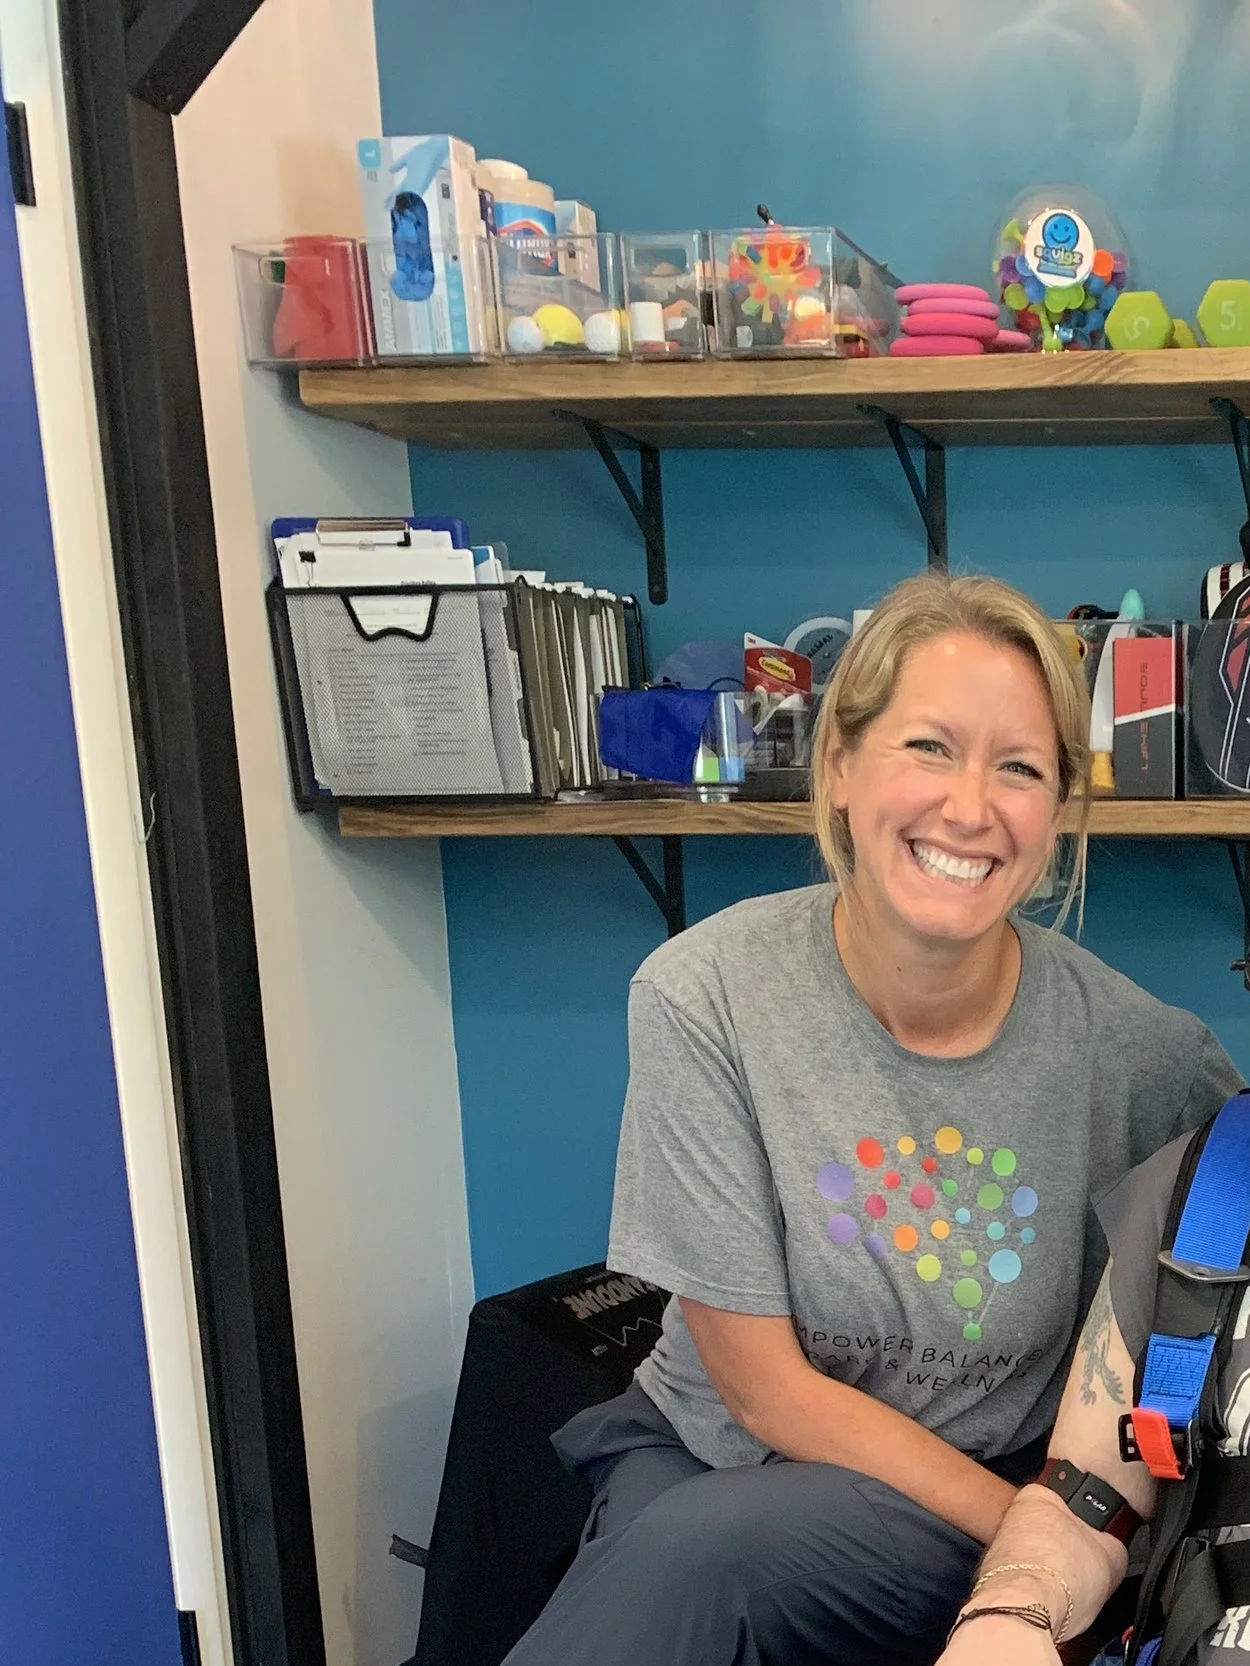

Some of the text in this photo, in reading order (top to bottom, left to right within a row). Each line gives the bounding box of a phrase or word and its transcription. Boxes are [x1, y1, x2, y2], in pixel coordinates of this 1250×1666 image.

[1034, 245, 1084, 266] squigz
[795, 1319, 912, 1354] MPOWER
[1085, 1494, 1107, 1511] PLAR
